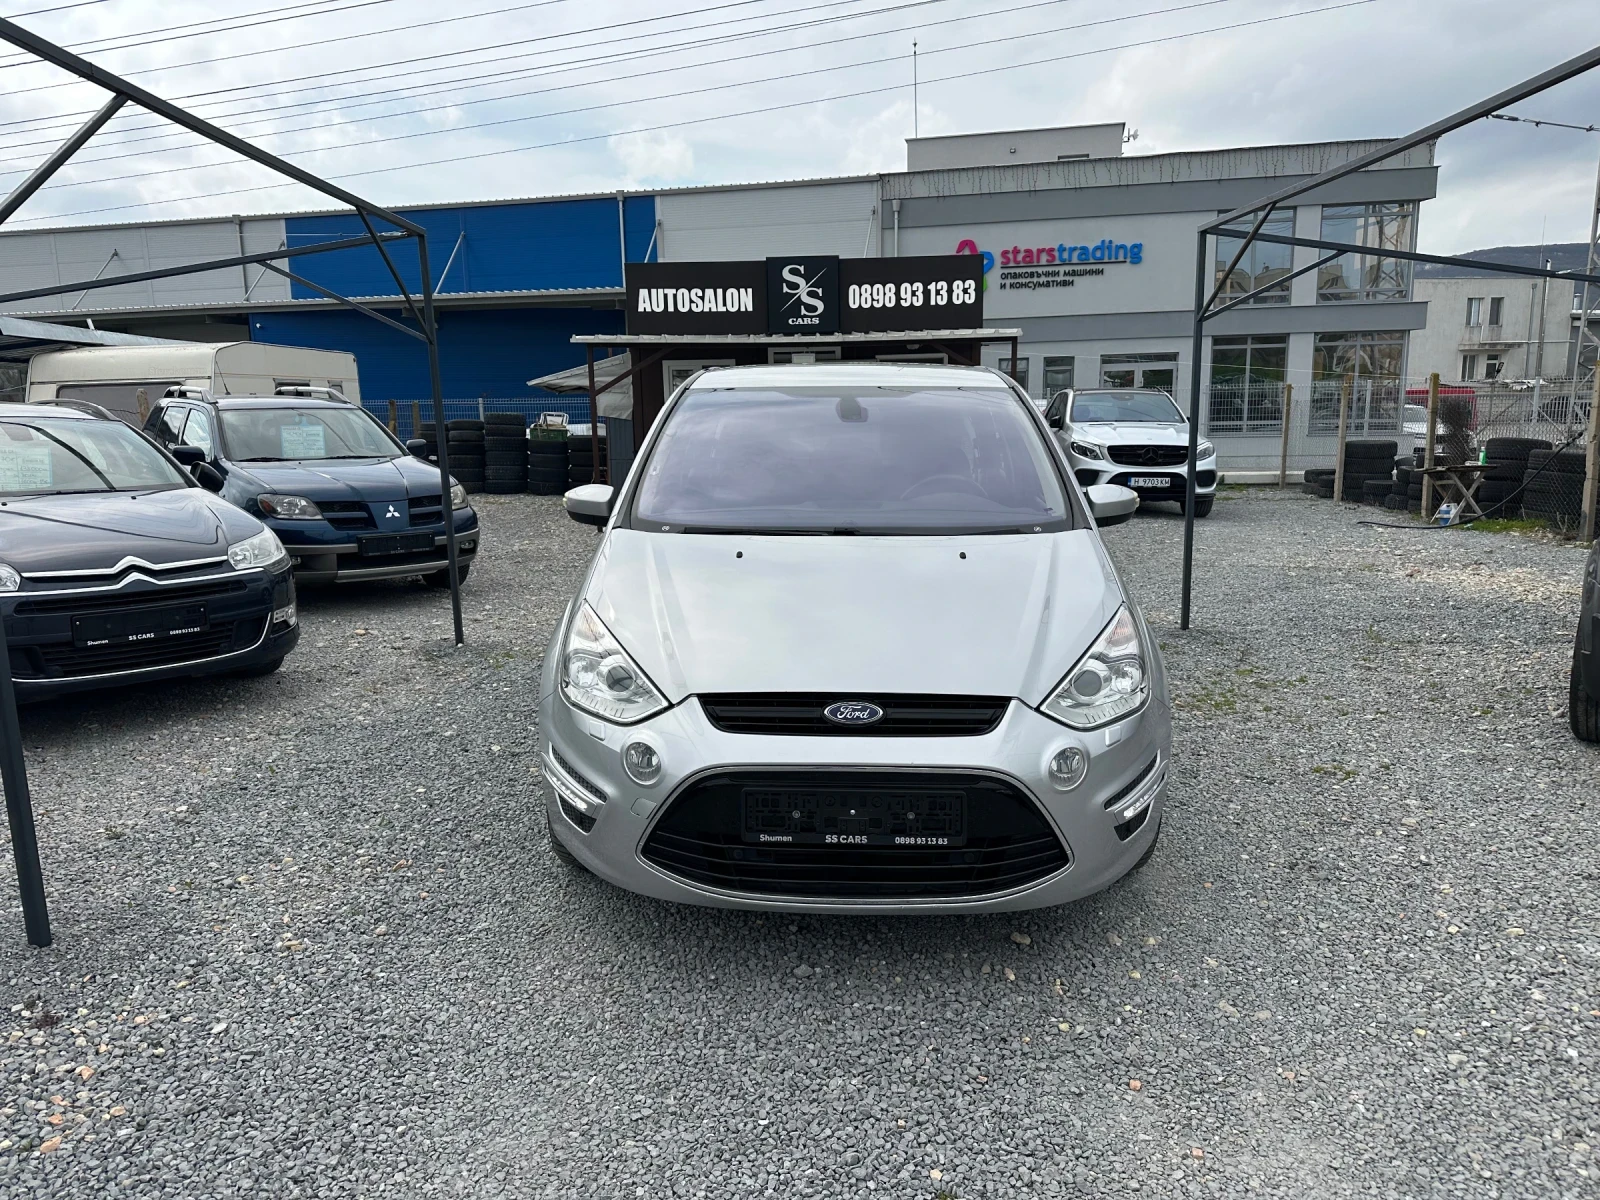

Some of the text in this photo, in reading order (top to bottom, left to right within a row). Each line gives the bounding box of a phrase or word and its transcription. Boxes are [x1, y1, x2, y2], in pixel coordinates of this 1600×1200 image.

[1000, 239, 1143, 265] starstrading
[1000, 267, 1104, 280] опаковъчни машини
[1000, 278, 1074, 290] и консумативи
[637, 287, 753, 313] AUTOSALON
[848, 279, 976, 309] 0898 93 13 83
[788, 317, 820, 325] CARS
[137, 632, 155, 640] CARS
[836, 705, 870, 719] Ford
[759, 834, 793, 842] Shumen
[825, 835, 838, 843] SS
[840, 835, 868, 844] CARS
[895, 837, 916, 845] 0898
[917, 837, 926, 845] 93
